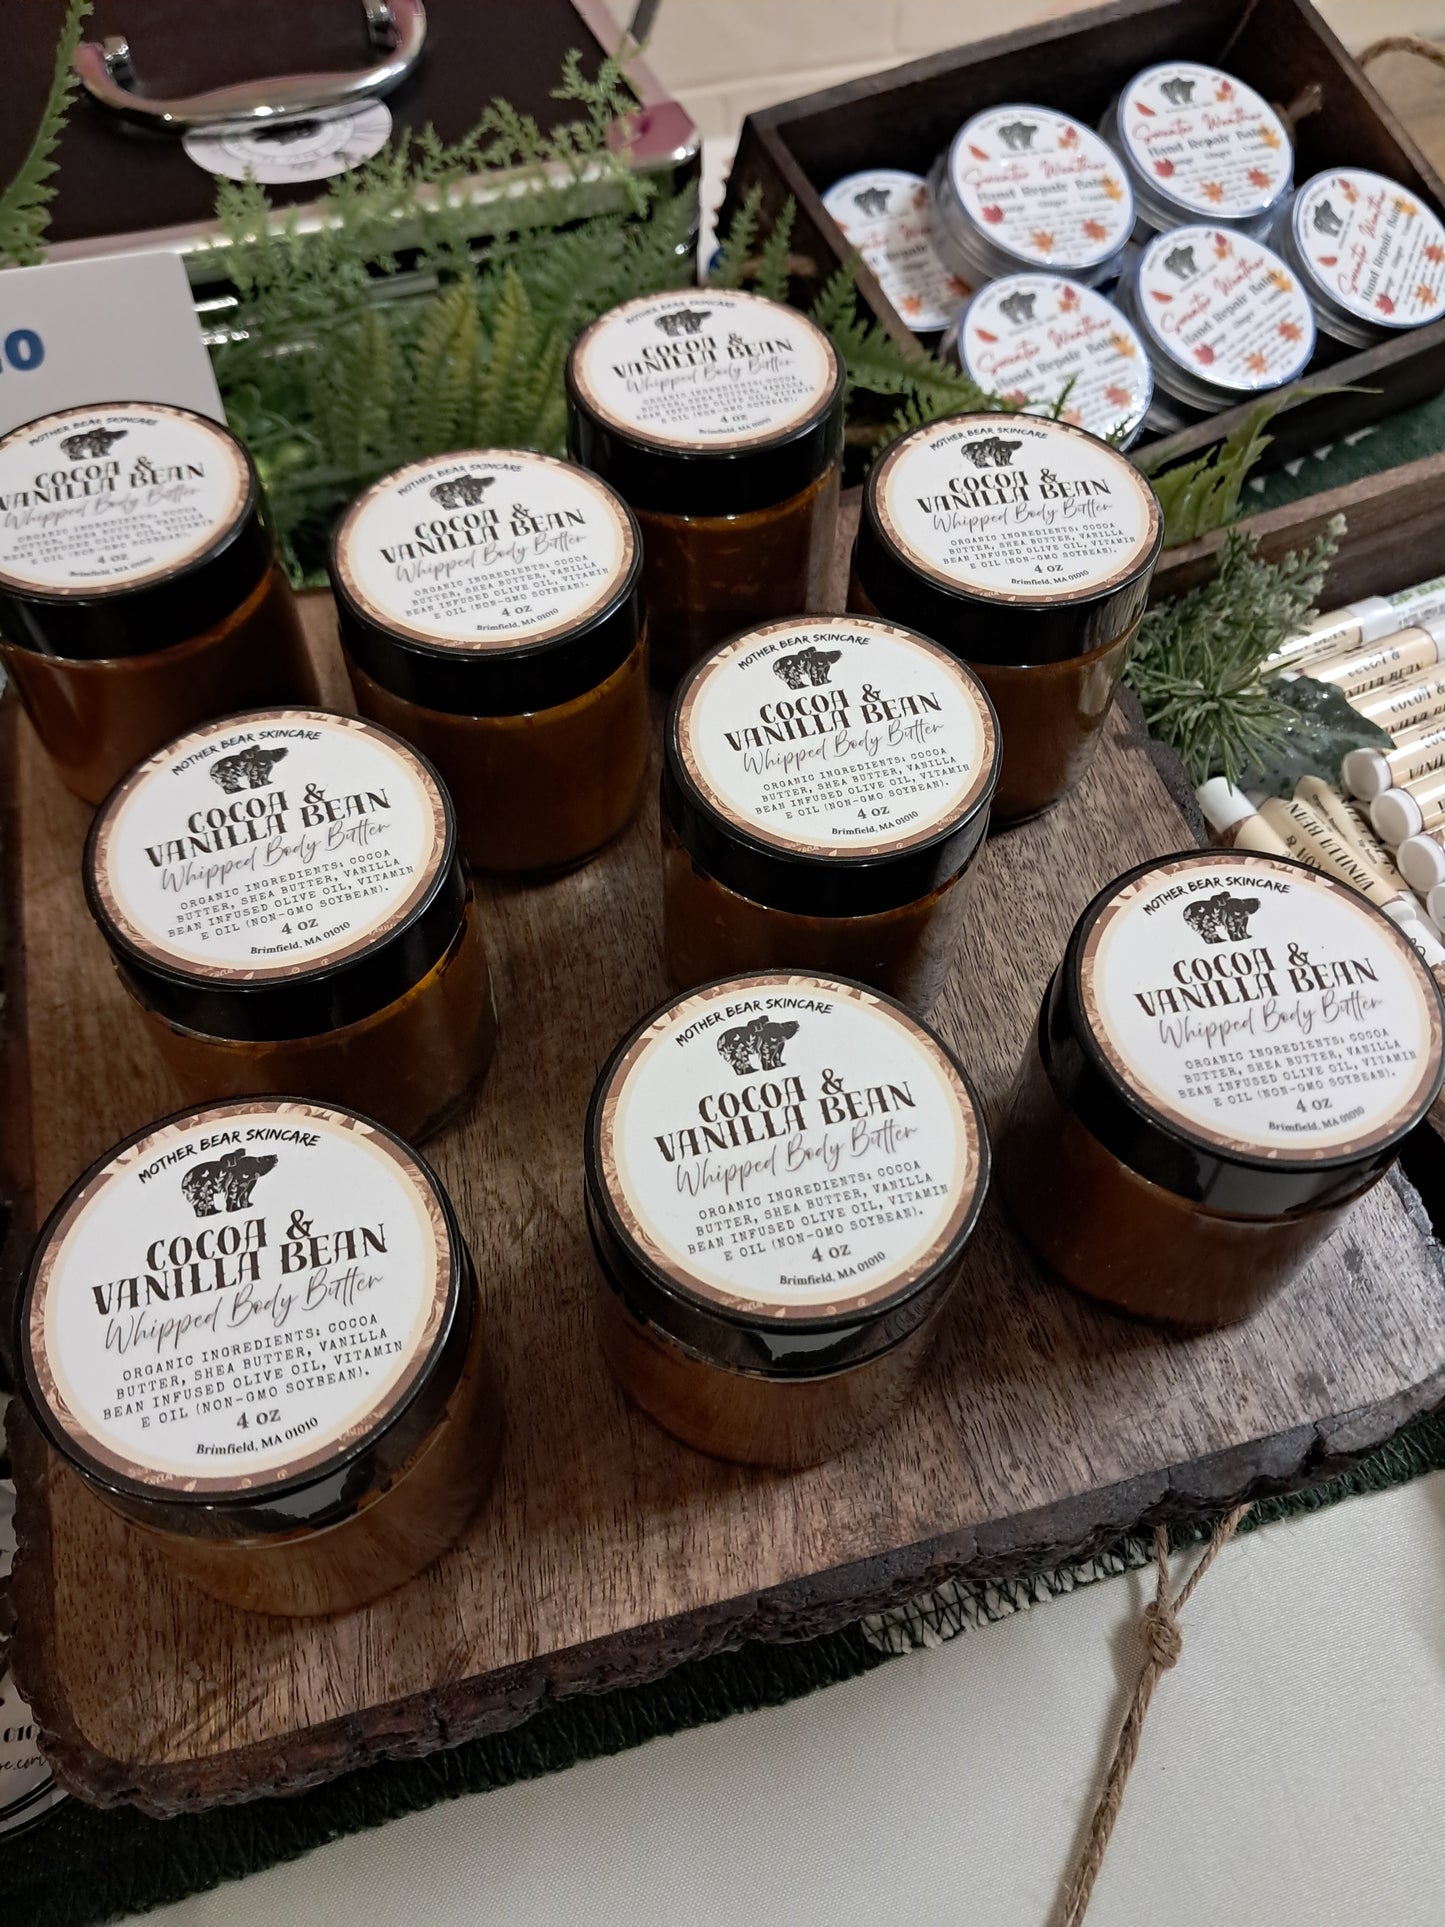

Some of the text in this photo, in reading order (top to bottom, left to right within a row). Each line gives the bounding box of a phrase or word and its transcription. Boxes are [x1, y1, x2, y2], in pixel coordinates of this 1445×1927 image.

[0, 327, 45, 374] 0
[930, 426, 1050, 450] MOTHER BEAR SKINCARE
[915, 478, 1112, 513] VANILLA BEAN
[948, 468, 1058, 493] COCOA &
[379, 508, 587, 563] VANILLA BEAN
[414, 503, 530, 539] COCOA &
[1034, 564, 1064, 573] 4 oz
[738, 633, 871, 670] MOTHER BEAR SKINCARE
[723, 691, 943, 751] VANILLA BEAN
[759, 683, 881, 724] COCOA &
[171, 729, 323, 775] MOTHER BEAR SKINCARE
[744, 718, 943, 775] Whipped Body Butter
[144, 787, 392, 867] VANILLA BEAN
[187, 782, 326, 834] COCOA &
[858, 806, 891, 819] 4 oz
[1287, 803, 1324, 837] BEAN
[162, 817, 390, 892] Whipped Body Butter
[1320, 837, 1376, 892] VANILLA
[1142, 876, 1292, 915] MOTHER BEAR SKINCARE
[282, 918, 319, 935] 4 oz
[1133, 958, 1380, 1017] VANILLA BEAN
[1172, 942, 1310, 985] COCOA &
[675, 998, 834, 1047] MOTHER BEAR SKINCARE
[1160, 989, 1383, 1050] Whipped Body Butter
[654, 1080, 917, 1162] VANILLA BEAN
[698, 1068, 844, 1123] COCOA &
[1270, 1105, 1367, 1131] Brimfield, MA 01010
[1297, 1097, 1334, 1112] 4 oz
[137, 1127, 320, 1184] MOTHER BEAR SKINCARE
[676, 1118, 917, 1196] Whipped Body Butter
[696, 1172, 933, 1236] BUTTER, SHEA BUTTER, VANILLA
[699, 1160, 921, 1220] ORGANIC INGREDIENTS: COCOA
[145, 1208, 313, 1271] COCOA &
[688, 1183, 949, 1254] BEAN INFUSED OLIVE OIL, VITAMIN
[724, 1206, 924, 1262] E OIL (NON-GMO SOYBEAN).
[90, 1222, 388, 1315] VANILLA BEAN
[781, 1251, 887, 1285] Brimfield, MA 01010
[812, 1244, 852, 1262] 4 oz
[105, 1265, 383, 1354] Whipped Body Butter
[116, 1327, 387, 1400] BUTTER, SHEA BUTTER, VANILLA
[122, 1313, 377, 1381] ORGANIC INGREDIENTS: COCOA
[103, 1340, 402, 1420] BEAN INFUSED OLIVE OIL, VITAMIN
[141, 1365, 369, 1428] E OIL (NON-GMO SOYBEAN).
[195, 1416, 318, 1455] Brimfield, MA 01010
[236, 1408, 281, 1429] 4 oz
